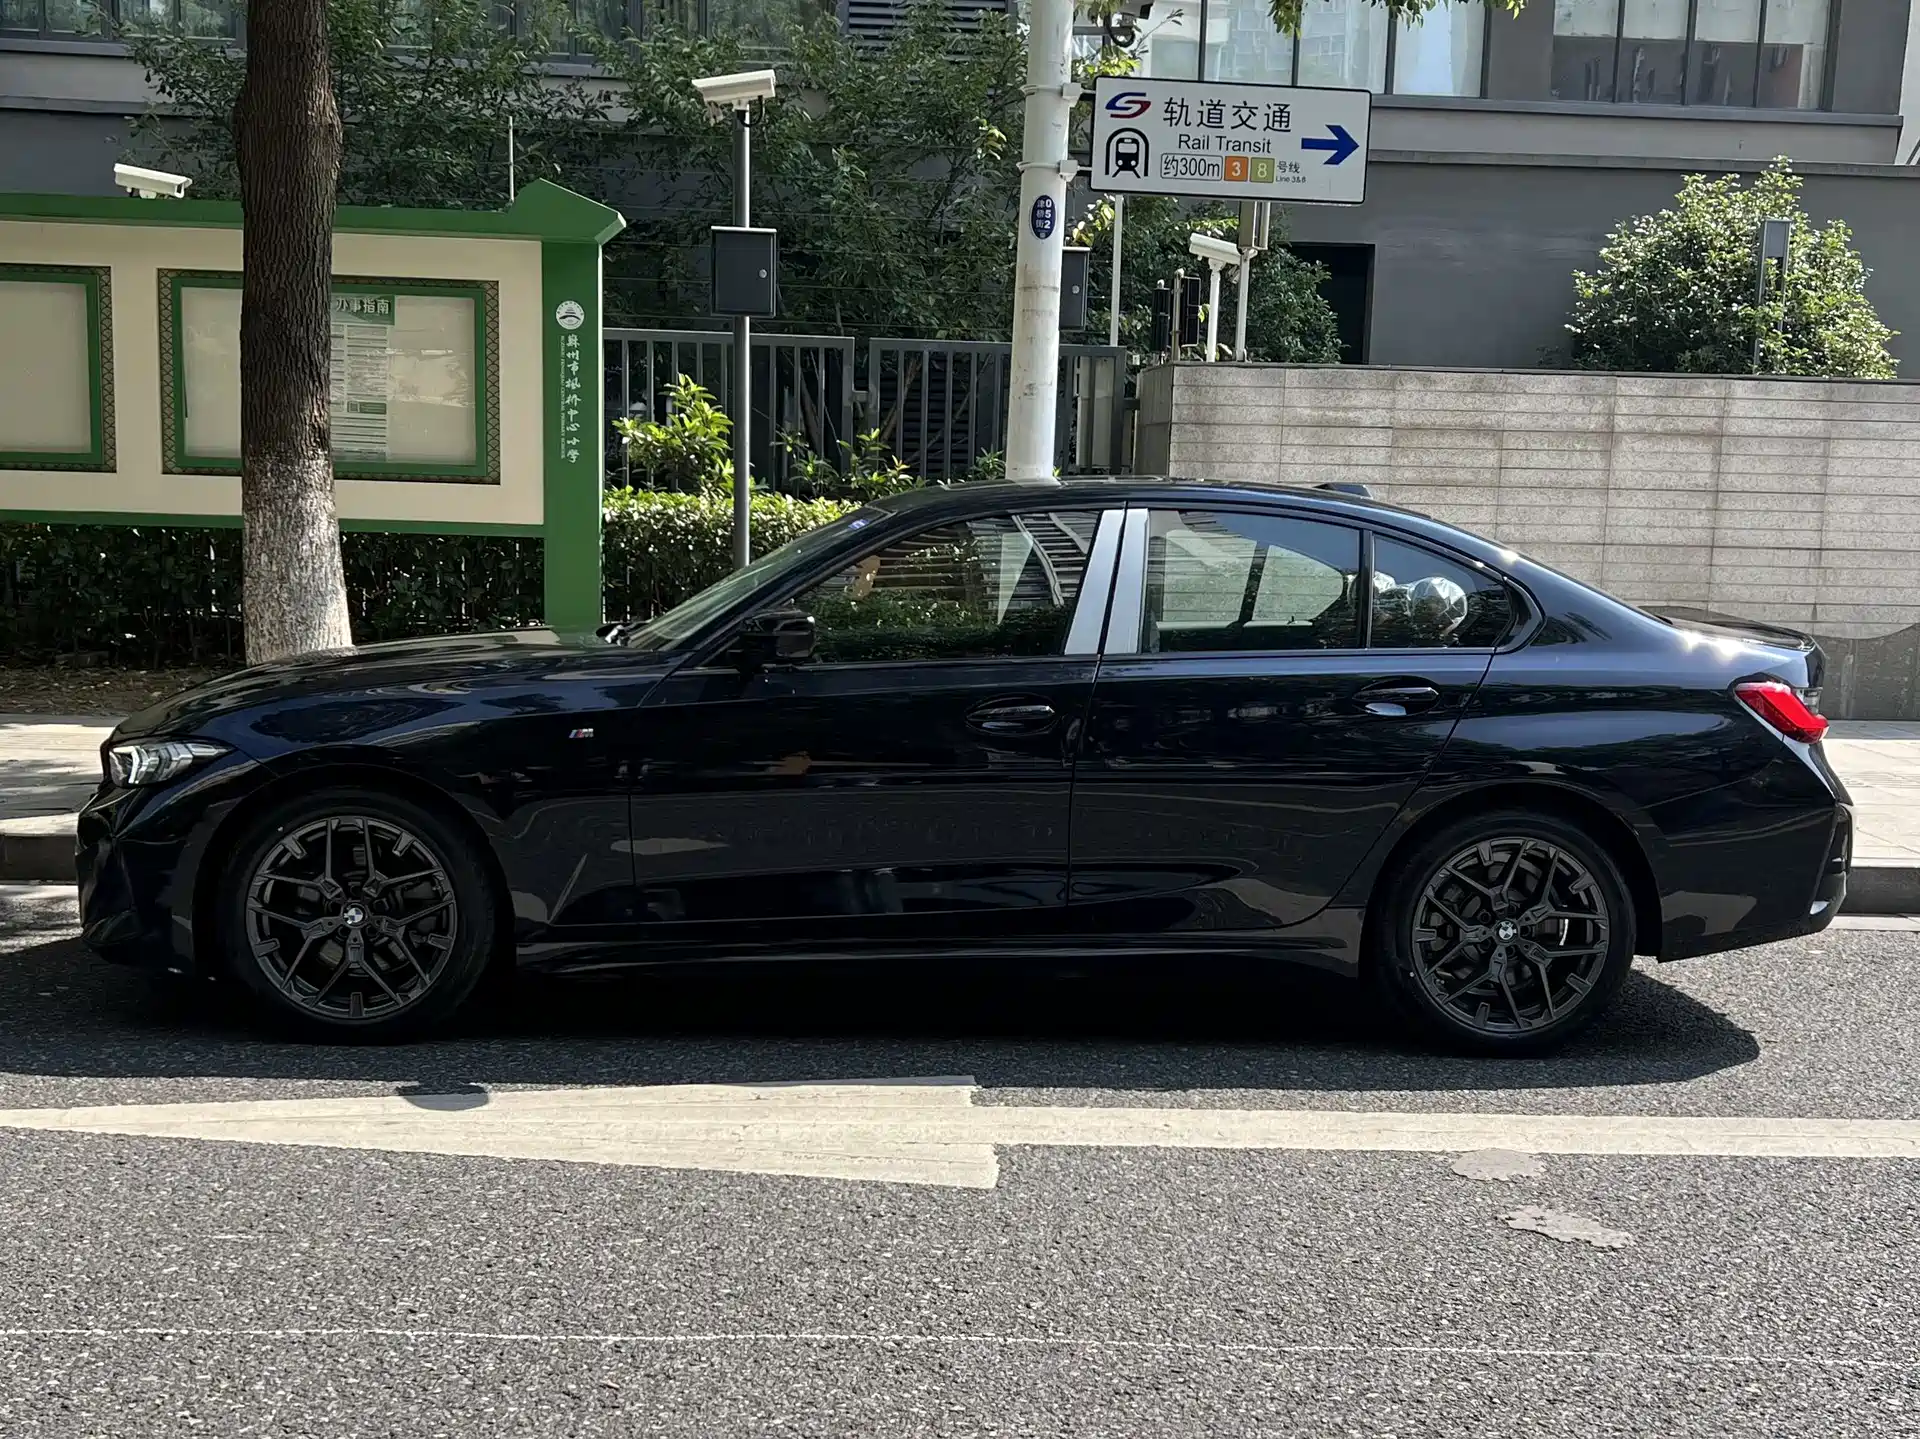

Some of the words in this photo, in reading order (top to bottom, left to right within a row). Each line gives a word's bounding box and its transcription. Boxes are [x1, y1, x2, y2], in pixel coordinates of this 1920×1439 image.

[1163, 97, 1292, 133] 轨道交通
[1178, 134, 1210, 150] Rail
[1215, 135, 1272, 154] Transit
[1163, 155, 1220, 178] 约300m
[1231, 161, 1241, 177] 3
[1256, 162, 1267, 178] 8
[1276, 160, 1301, 174] 号线
[1043, 199, 1052, 229] 052
